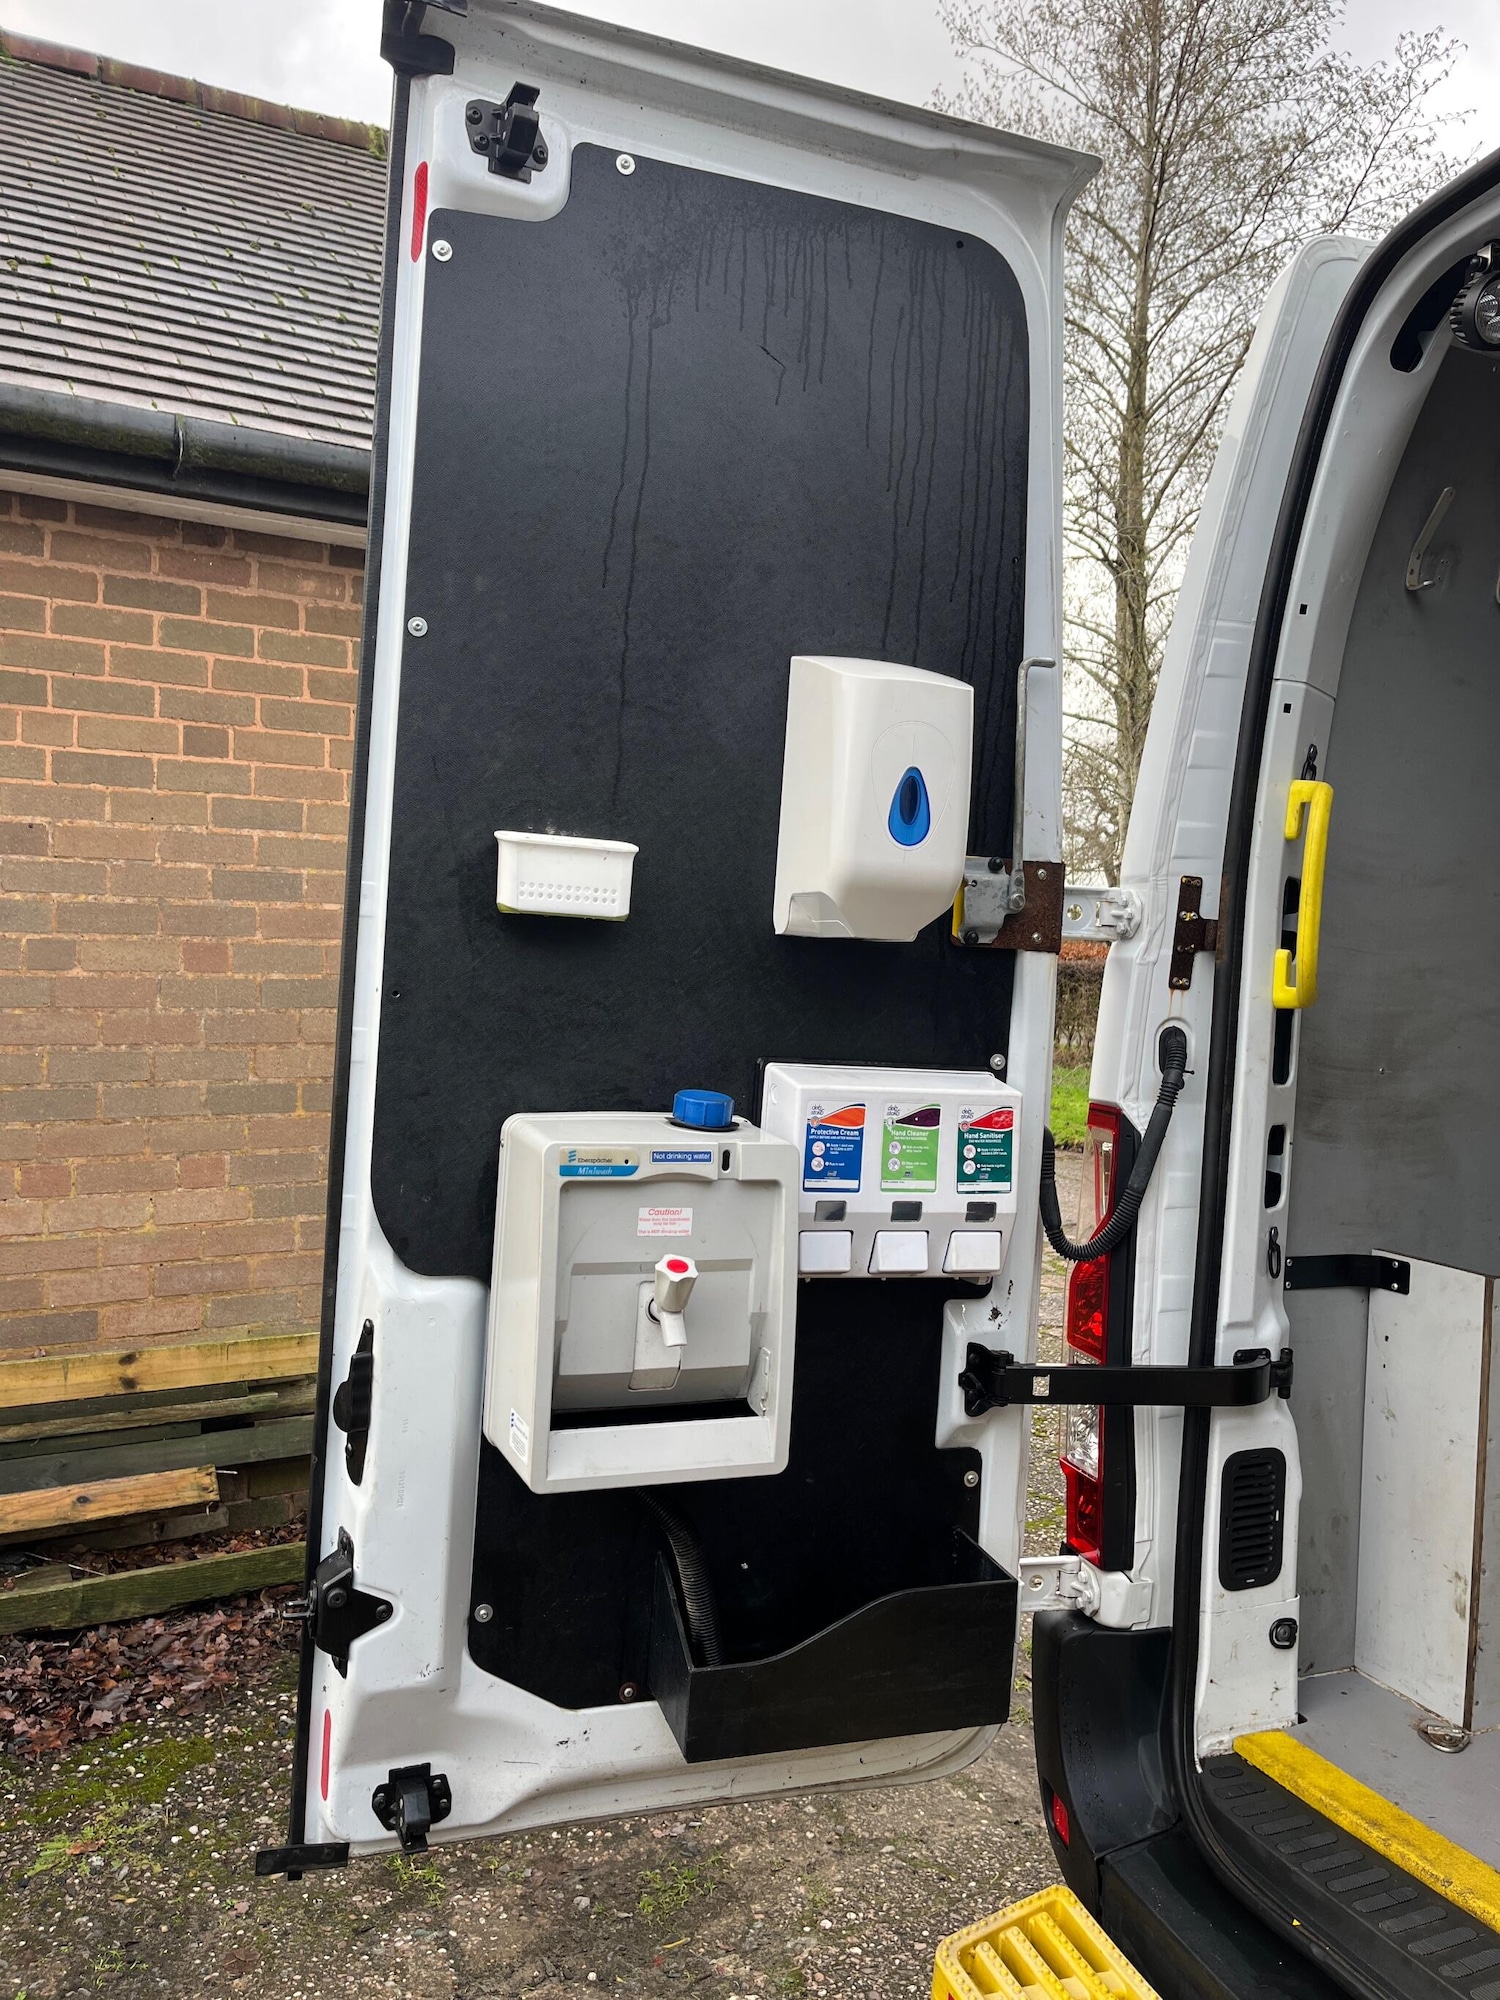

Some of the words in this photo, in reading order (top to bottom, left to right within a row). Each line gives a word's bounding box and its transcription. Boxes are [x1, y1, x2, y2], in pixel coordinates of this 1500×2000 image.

[666, 1153, 692, 1161] drinking
[577, 1166, 613, 1175] Miniwash
[647, 1208, 683, 1216] Caution!
